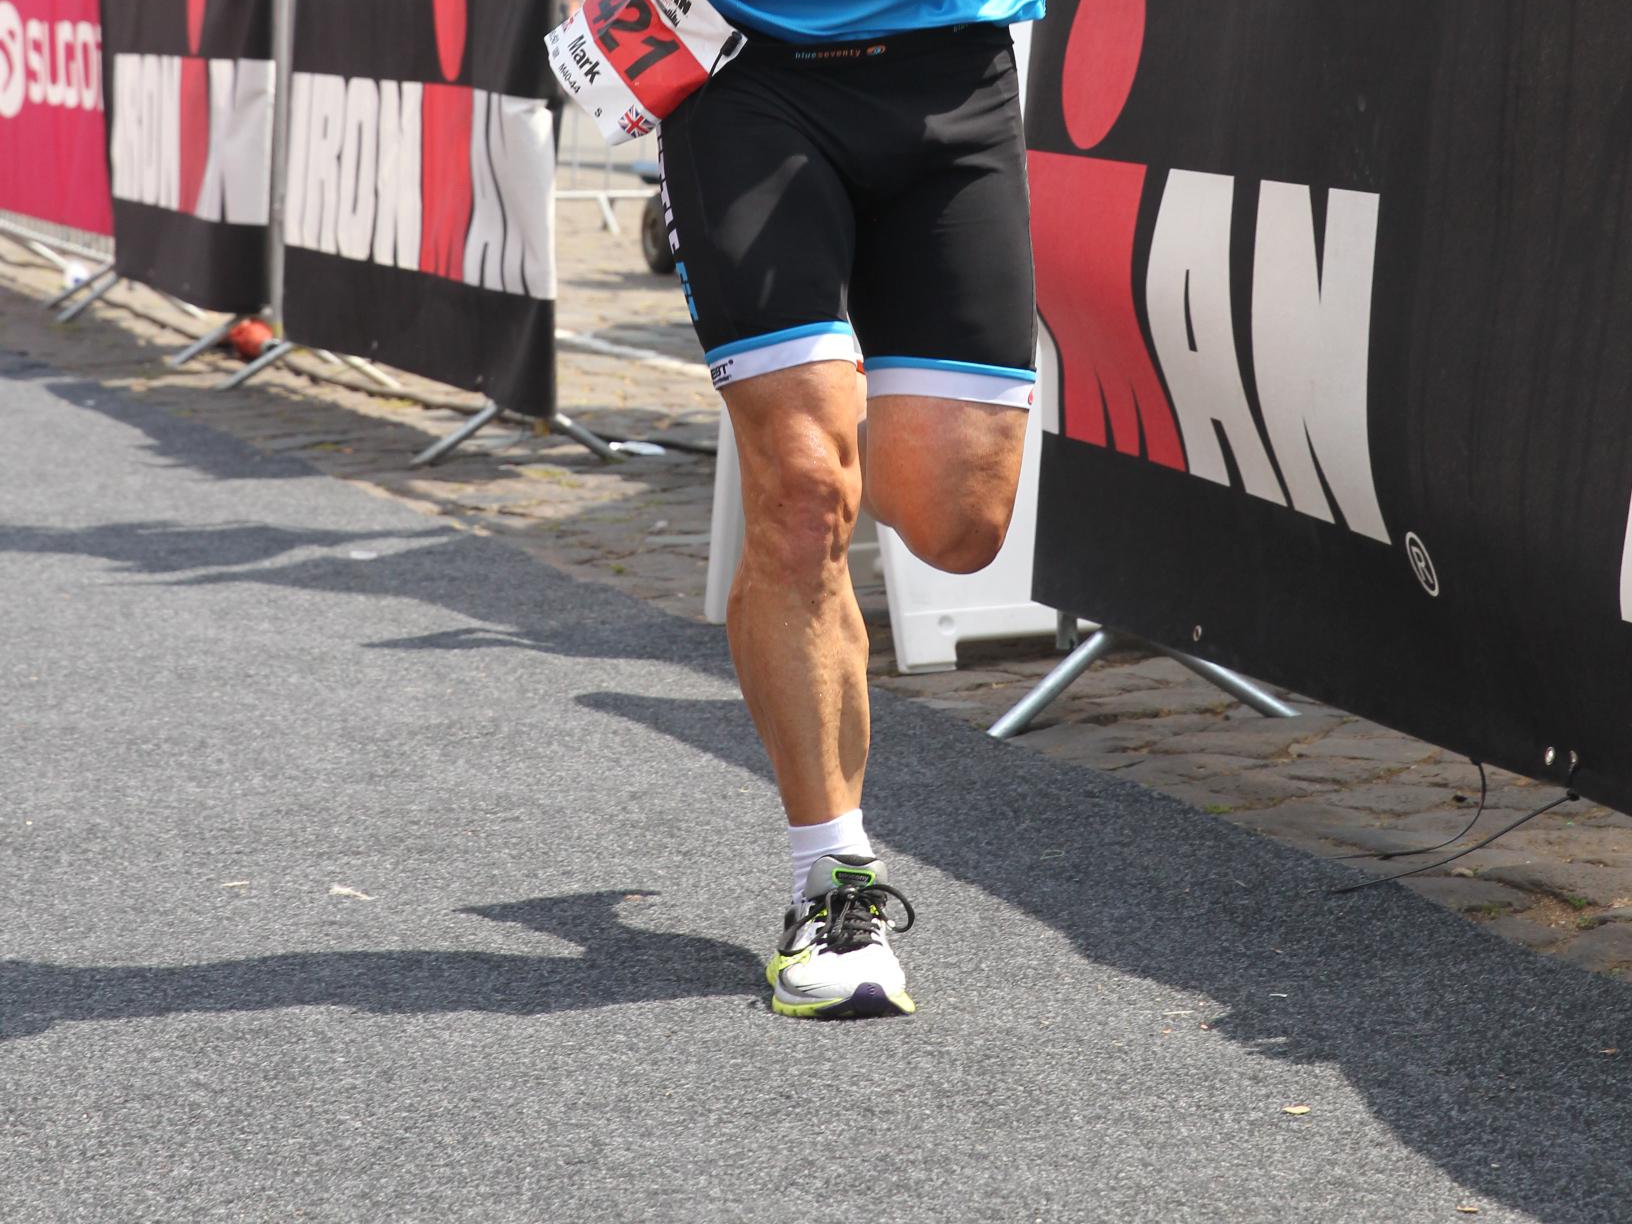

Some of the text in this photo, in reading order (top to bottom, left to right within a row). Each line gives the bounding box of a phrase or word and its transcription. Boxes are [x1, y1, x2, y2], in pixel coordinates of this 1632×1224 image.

[558, 62, 581, 94] M40-44
[567, 34, 603, 86] Mark
[284, 71, 557, 300] IRONMAN
[1026, 148, 1393, 546] MAN
